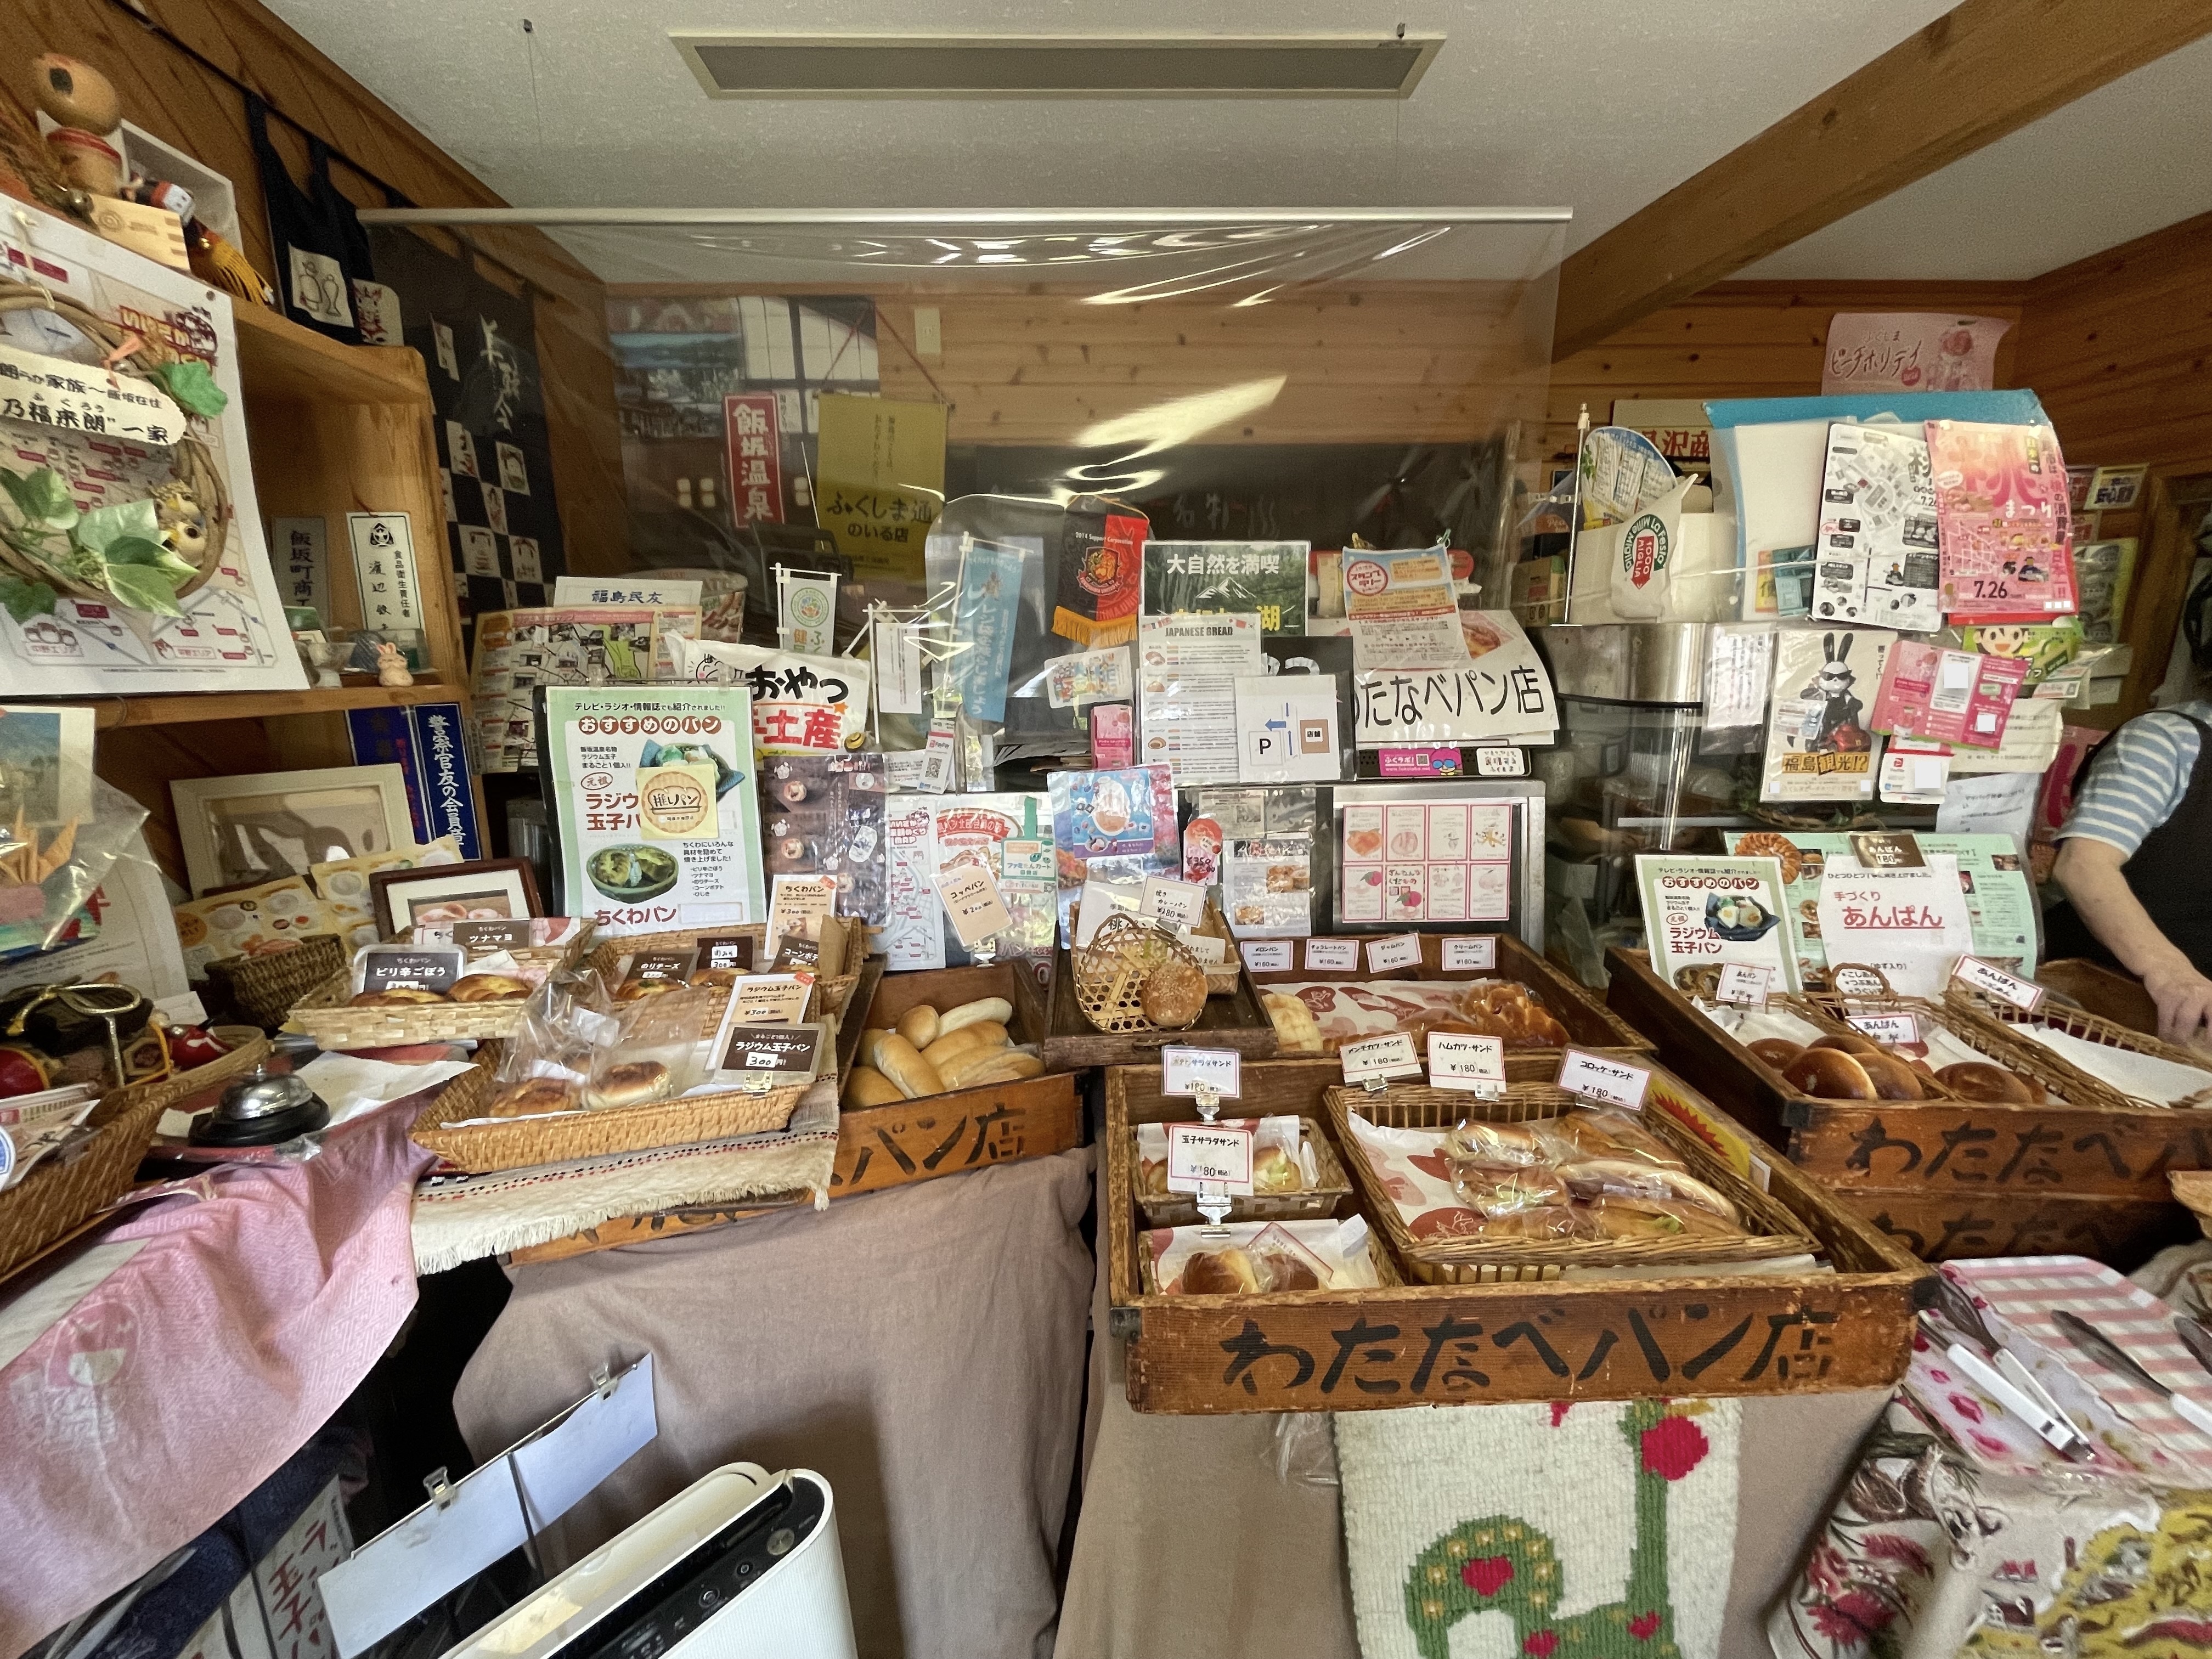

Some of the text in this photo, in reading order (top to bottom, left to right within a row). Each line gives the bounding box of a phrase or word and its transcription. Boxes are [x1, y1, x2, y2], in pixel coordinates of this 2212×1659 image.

[732, 403, 774, 521] 飯坂温泉
[826, 492, 933, 523] ふくしま通
[2005, 498, 2052, 519] まつり
[848, 523, 909, 543] のいる店
[1658, 529, 1667, 565] Festa
[1167, 554, 1279, 575] 大自然を満喫
[1634, 539, 1644, 578] MIGLIA
[1643, 541, 1652, 575] 1000
[394, 550, 410, 618] 食品衛生責任者
[1974, 580, 2008, 599] 7.26
[591, 589, 664, 605] 福島民友
[1165, 626, 1233, 637] JAPANESE BREAD
[745, 665, 849, 705] おやつ
[579, 716, 721, 735] おすすめのパン
[1259, 737, 1272, 755] P
[586, 776, 610, 787] 元祖
[652, 793, 699, 808] 推しパン
[785, 884, 825, 894] ちくわパン
[950, 879, 984, 899] コッペパン
[1662, 876, 1759, 890] おすすめのパン
[1157, 898, 1188, 909] カレーパン
[1834, 891, 1881, 902] 手づくり
[594, 906, 677, 927] ちくわパン
[1156, 907, 1175, 918] ¥180
[1842, 905, 1943, 927] あんぱん
[470, 934, 513, 943] ツナマヨ
[1670, 927, 1720, 940] ラジウム
[1671, 940, 1723, 955] 玉子パン
[376, 967, 446, 977] ピリ辛ごぼう
[747, 984, 803, 992] ラジウム玉子パン
[735, 1041, 811, 1052] ラジウム玉子パン
[1437, 1042, 1493, 1053] ハムカツ・サンド
[1450, 1063, 1475, 1073] ¥180
[1579, 1059, 1634, 1081] コロッケ・サンド
[1582, 1083, 1609, 1098] ¥180
[1181, 1135, 1240, 1147] 玉子サラダサンド
[1190, 1165, 1215, 1177] ¥180
